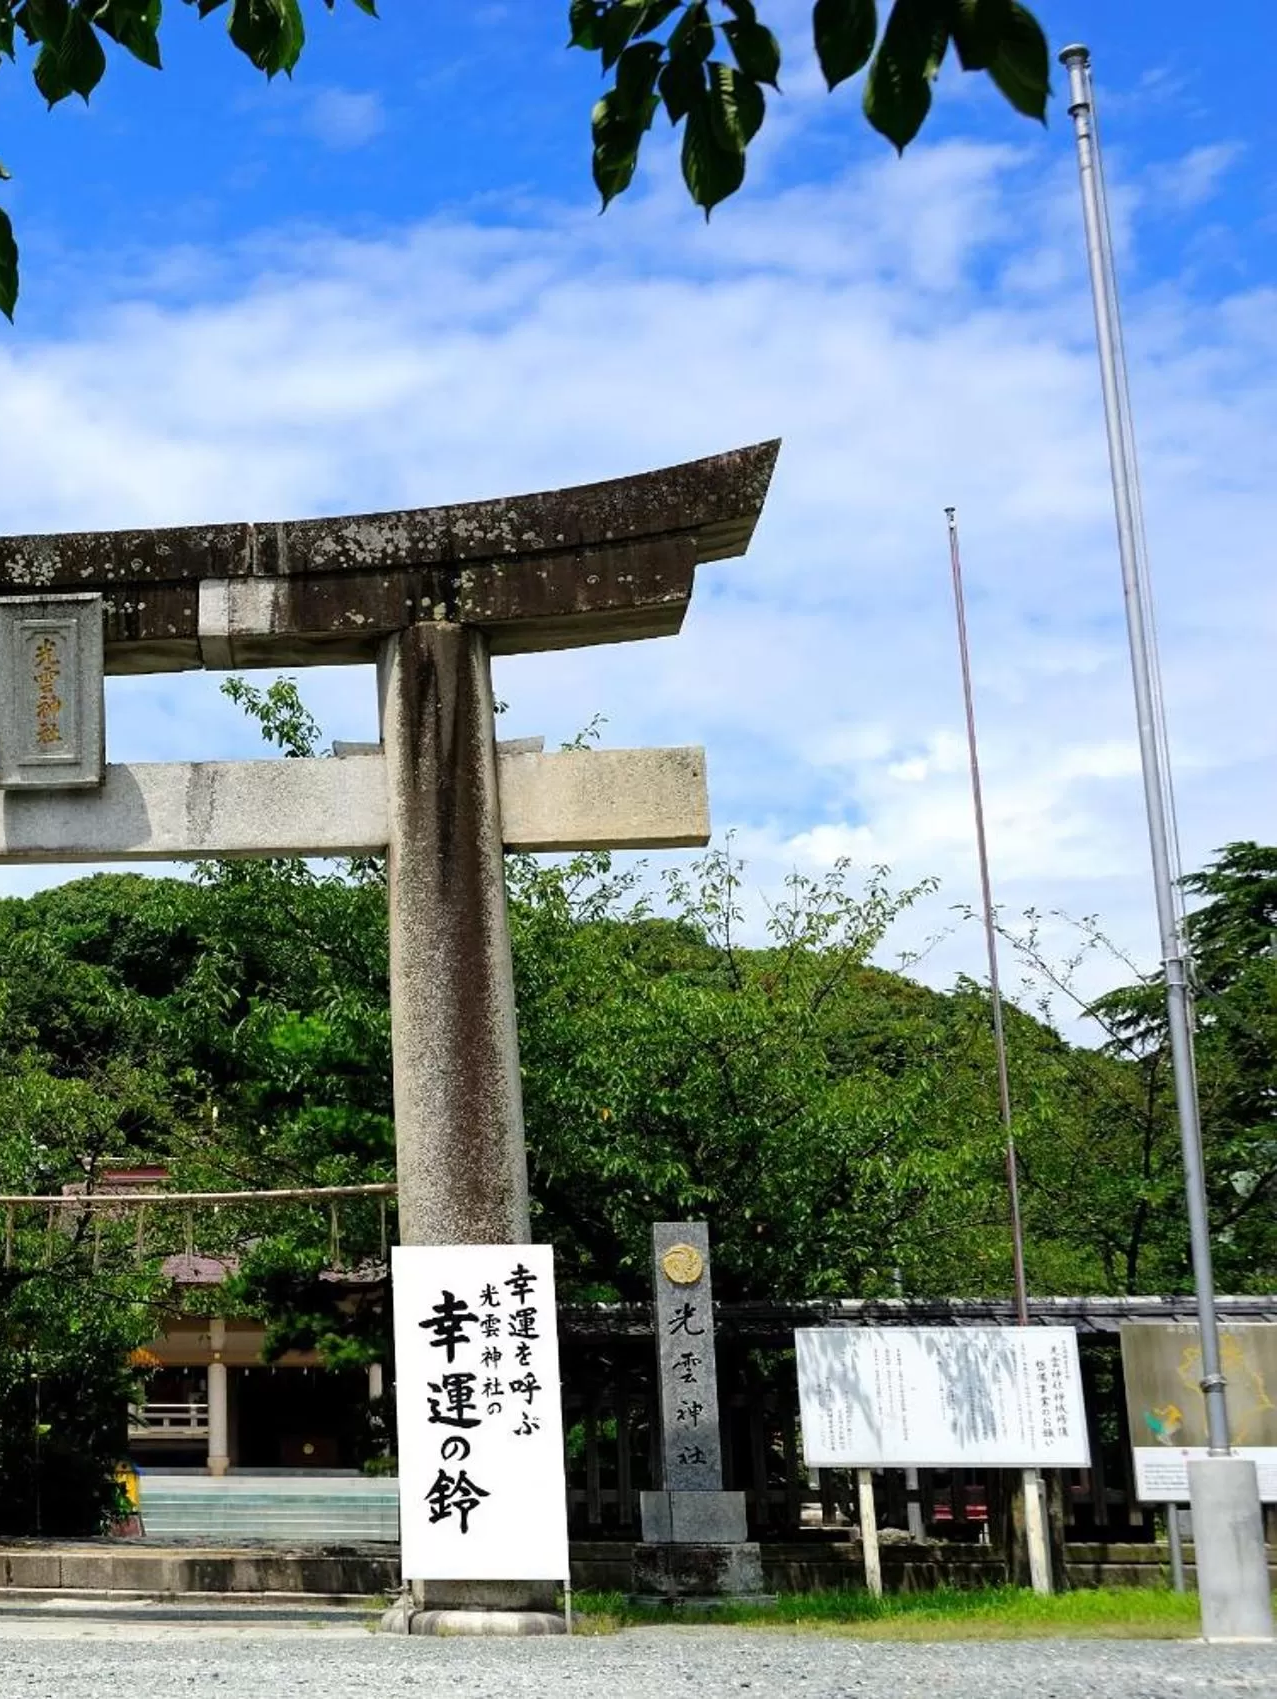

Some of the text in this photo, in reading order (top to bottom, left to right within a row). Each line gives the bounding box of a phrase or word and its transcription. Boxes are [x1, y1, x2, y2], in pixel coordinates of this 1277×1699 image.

[34, 637, 62, 744] 光雲神社
[418, 1290, 492, 1535] 幸運の鈴
[479, 1282, 505, 1416] 光雲神社の
[504, 1263, 543, 1437] 幸運を呼ぶ
[668, 1302, 708, 1465] 光雲神社
